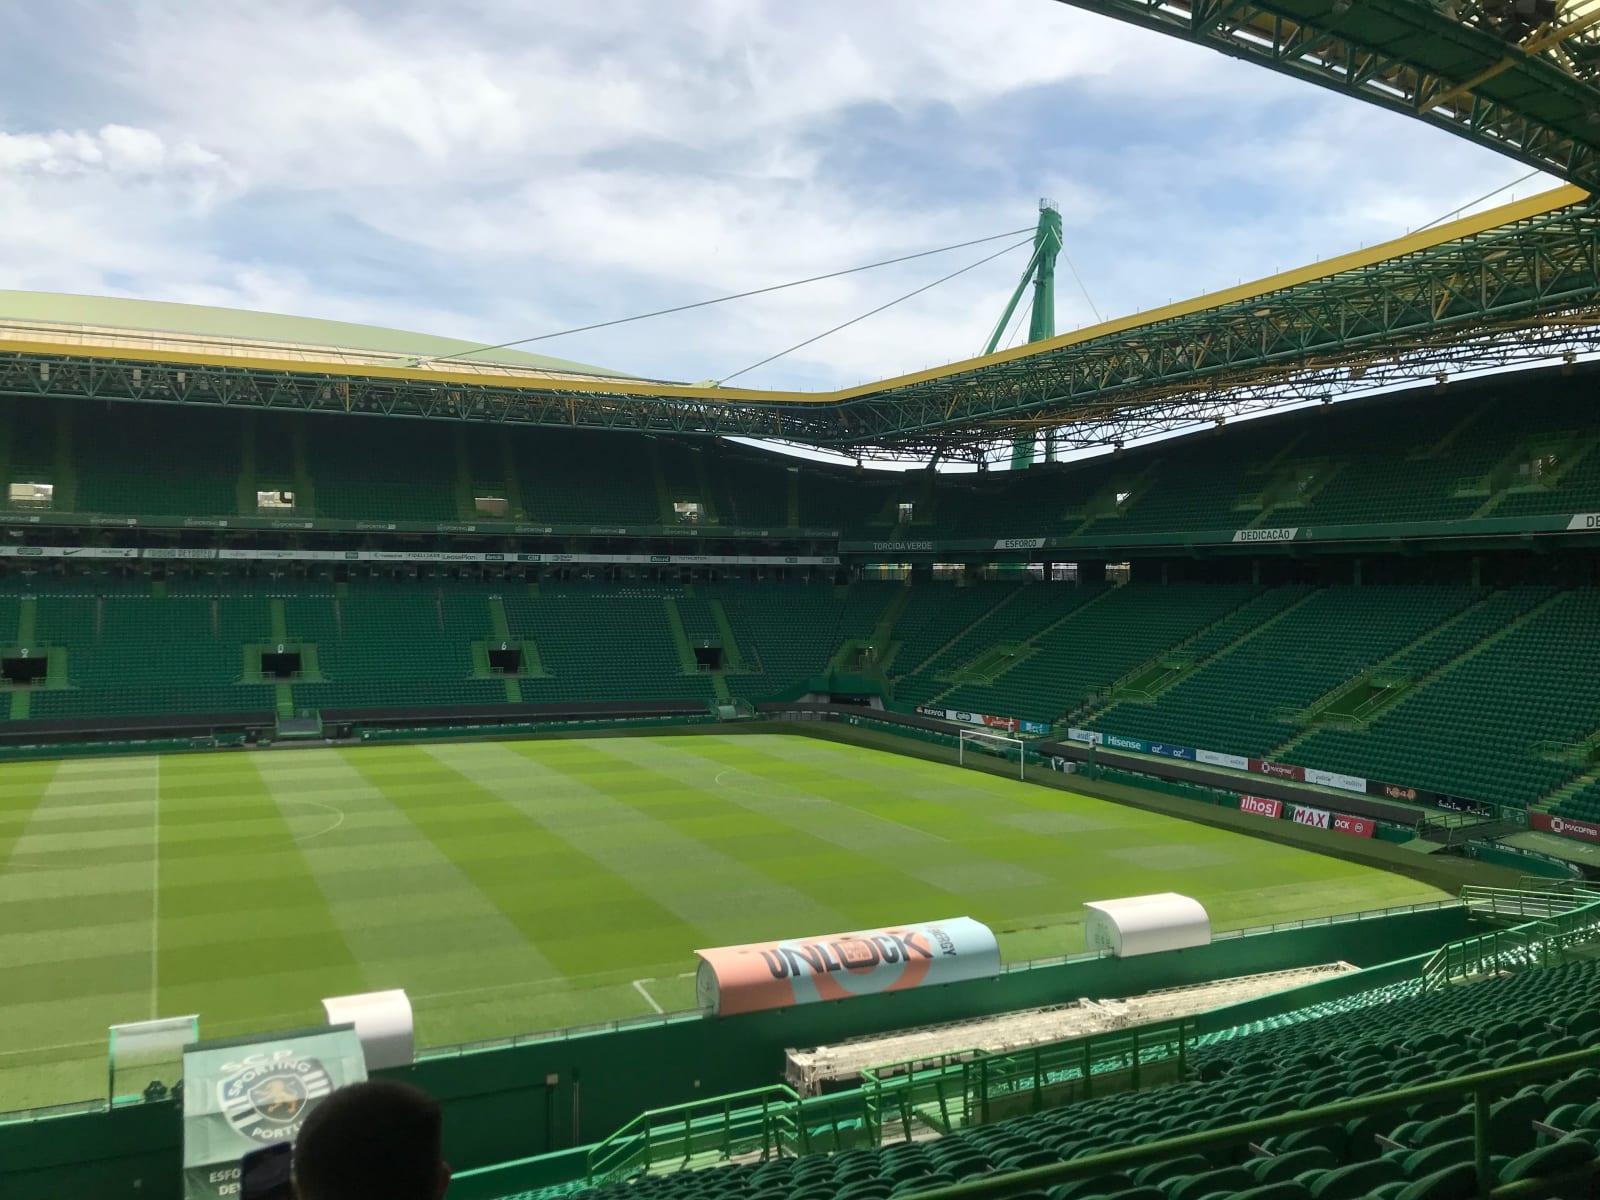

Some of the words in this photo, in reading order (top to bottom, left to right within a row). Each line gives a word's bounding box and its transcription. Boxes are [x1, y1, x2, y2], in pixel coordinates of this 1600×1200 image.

[873, 542, 905, 551] TORCIDA
[906, 542, 933, 550] VERDE
[1107, 735, 1142, 750] Hisense
[1294, 808, 1325, 827] MAX
[759, 931, 934, 979] UNLOCK
[228, 1060, 311, 1097] SPORTING
